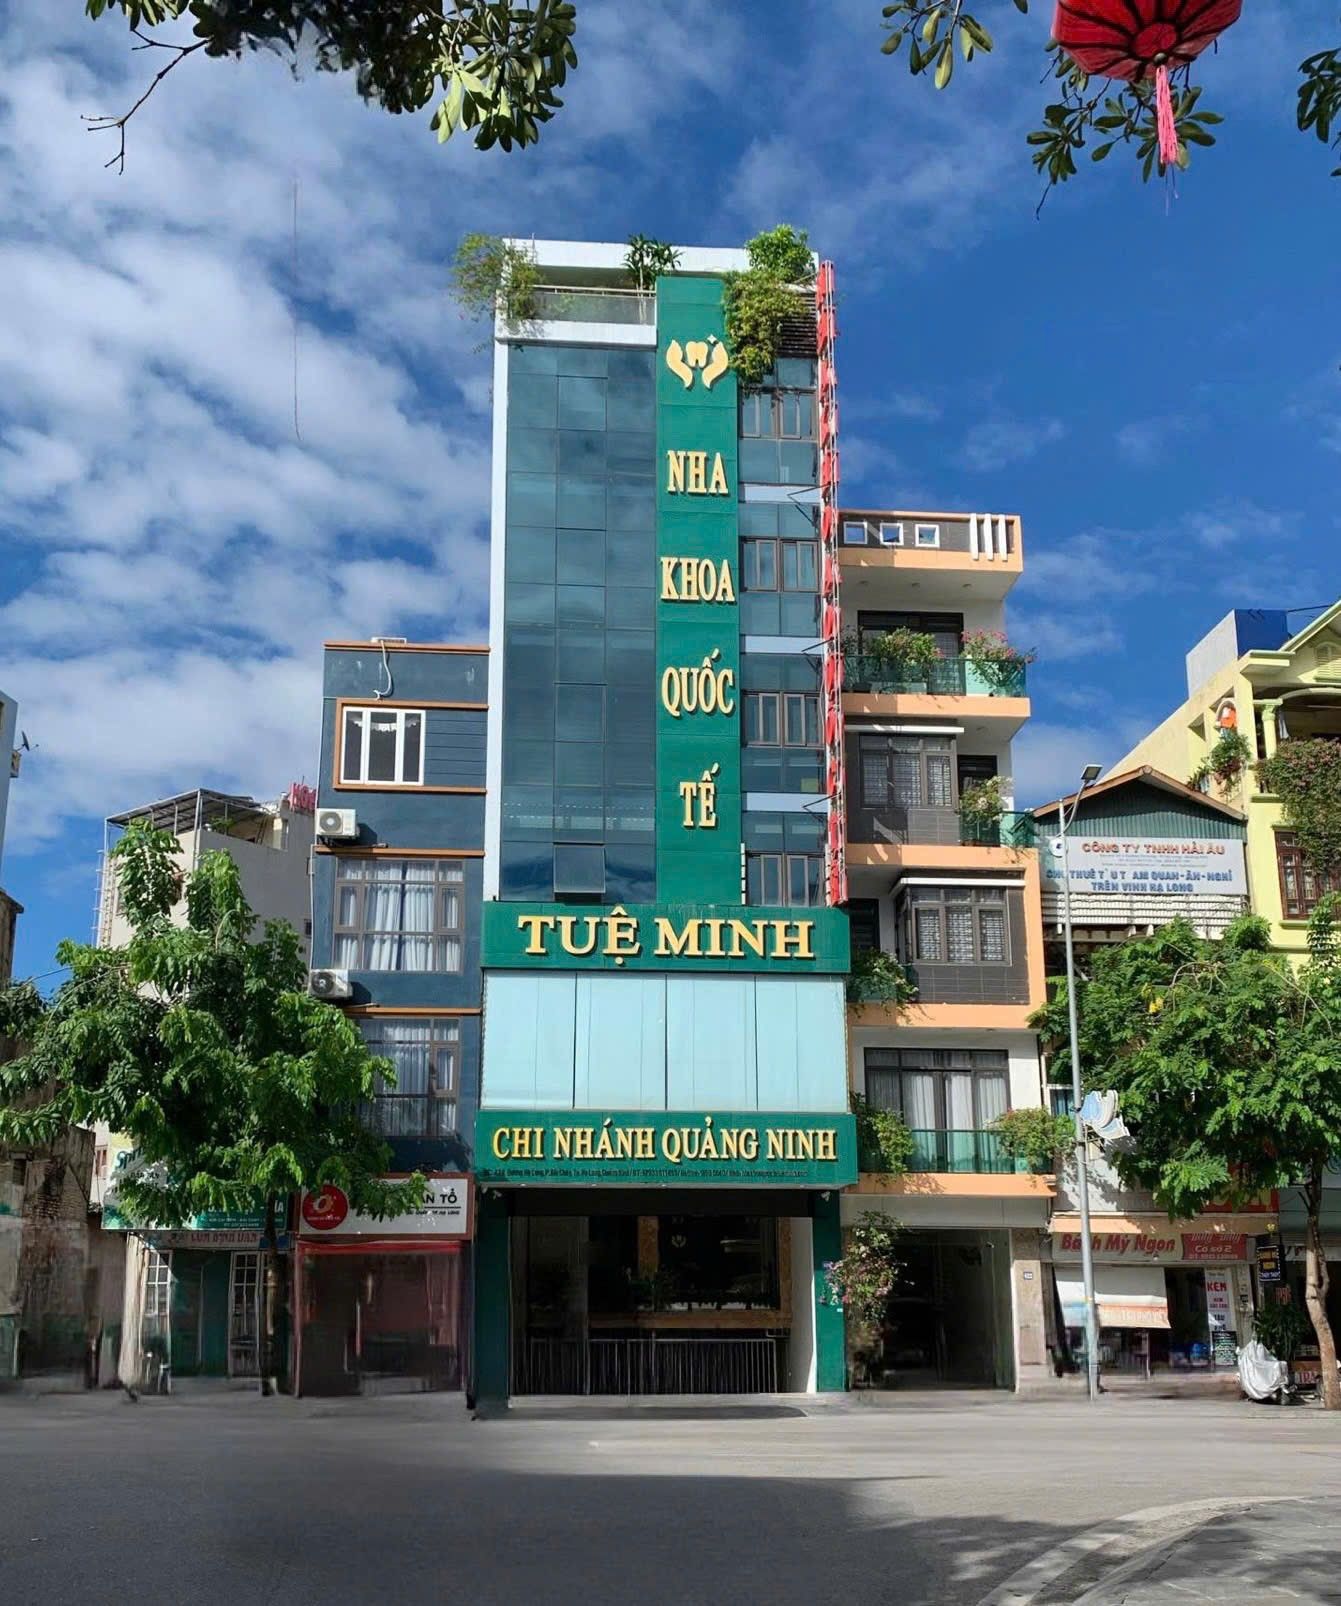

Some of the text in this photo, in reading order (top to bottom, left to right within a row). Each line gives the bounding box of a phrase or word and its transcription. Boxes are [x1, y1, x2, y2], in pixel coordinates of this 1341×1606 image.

[667, 450, 728, 495] NHA
[660, 557, 735, 603] KHOA
[661, 648, 735, 718] QUỐC
[679, 762, 720, 828] TẾ
[1081, 841, 1119, 854] CÔNG
[1122, 843, 1141, 854] TY
[1143, 844, 1180, 855] TNHH
[1069, 868, 1096, 880] THUÊ
[1091, 880, 1119, 892] TRÊN
[1166, 883, 1194, 893] LONG
[517, 906, 815, 965] TUỆ MINH
[492, 1116, 837, 1164] CHI NHÁNH QUẢNG NINH
[439, 1187, 458, 1204] TỔ
[1223, 1244, 1233, 1253] 2
[1206, 1281, 1227, 1292] KEM
